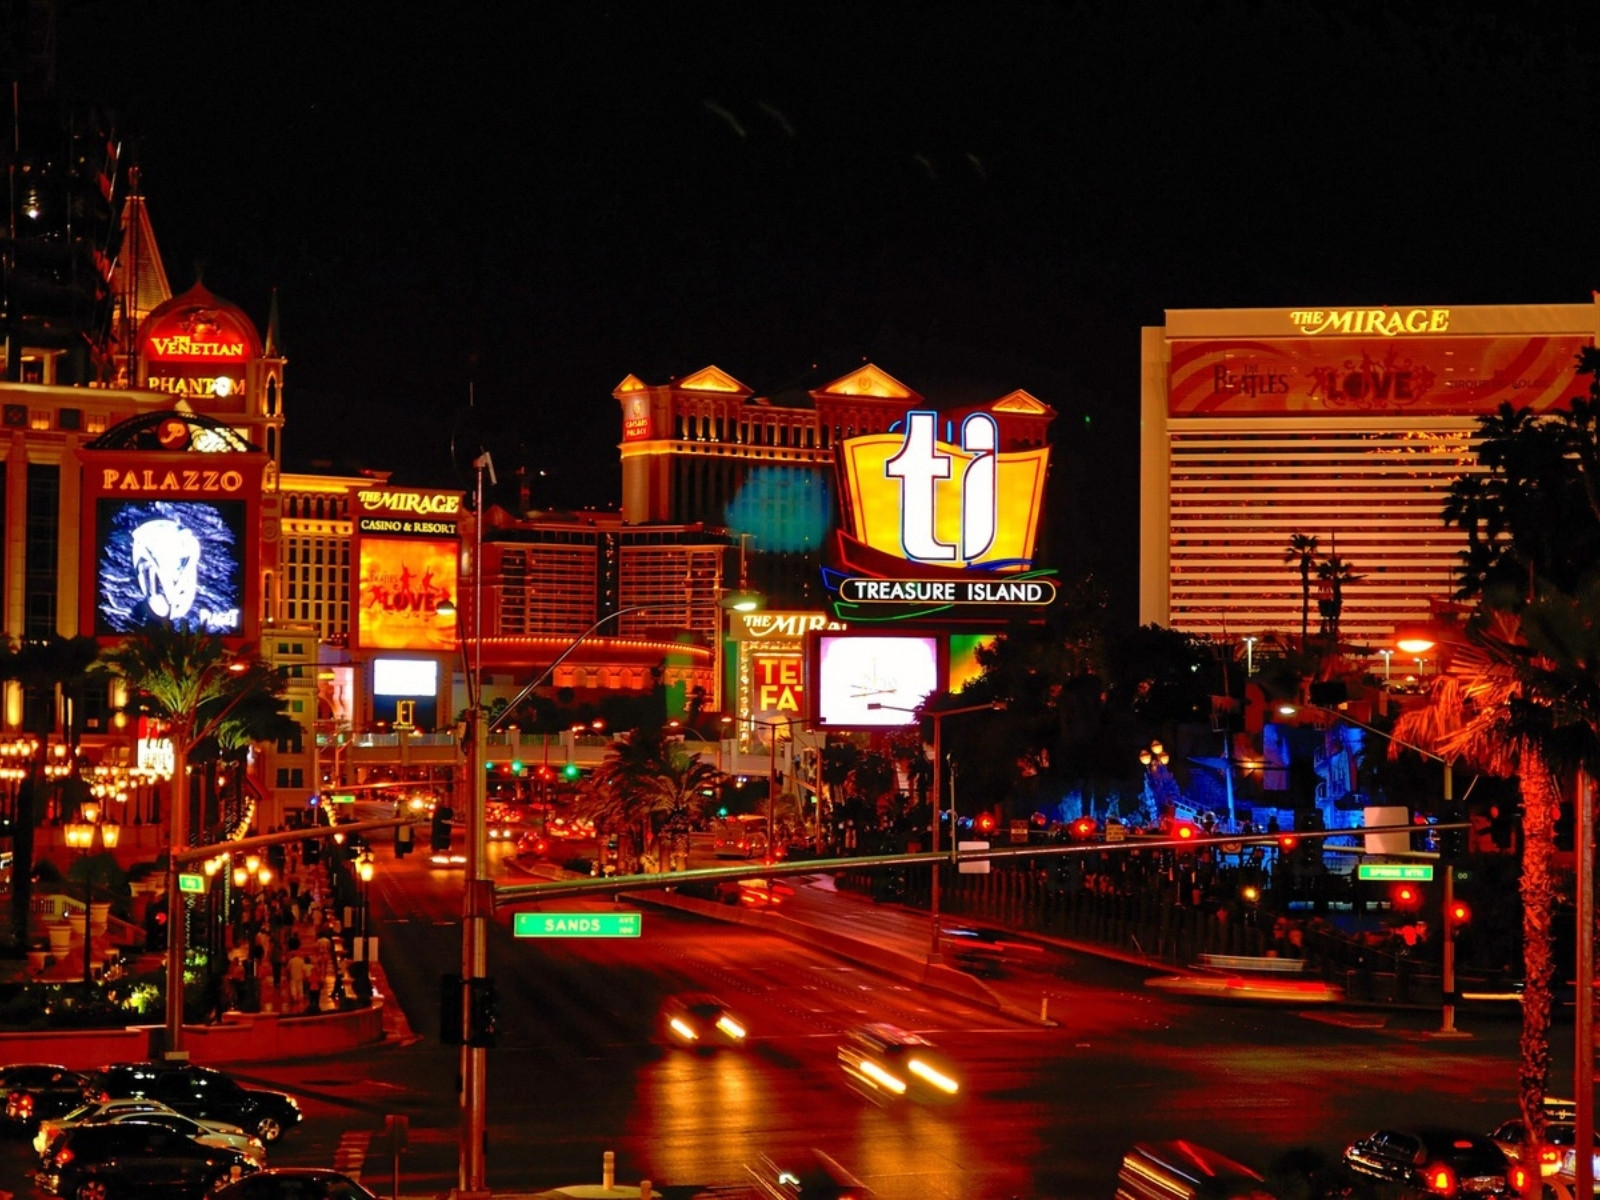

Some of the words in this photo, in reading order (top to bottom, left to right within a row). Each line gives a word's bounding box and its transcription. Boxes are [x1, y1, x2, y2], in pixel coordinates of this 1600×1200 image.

[1290, 310, 1324, 325] THE
[1299, 309, 1450, 334] MIRAGE
[150, 337, 244, 357] VENETIAN
[1213, 364, 1289, 398] BEATLES
[1326, 371, 1414, 400] LOVE
[102, 469, 243, 492] PALAZZO
[358, 491, 381, 503] THE
[364, 492, 460, 515] MIRAGE
[360, 519, 402, 532] CASINO
[403, 521, 412, 532] &
[413, 522, 457, 534] RESORT
[381, 591, 436, 612] LOVE
[854, 581, 956, 601] TREASURE
[967, 582, 1042, 602] ISLAND
[743, 615, 772, 627] THE
[749, 615, 847, 637] MIRA
[759, 659, 803, 685] TE
[393, 700, 416, 725] JET
[544, 918, 601, 932] SANDS
